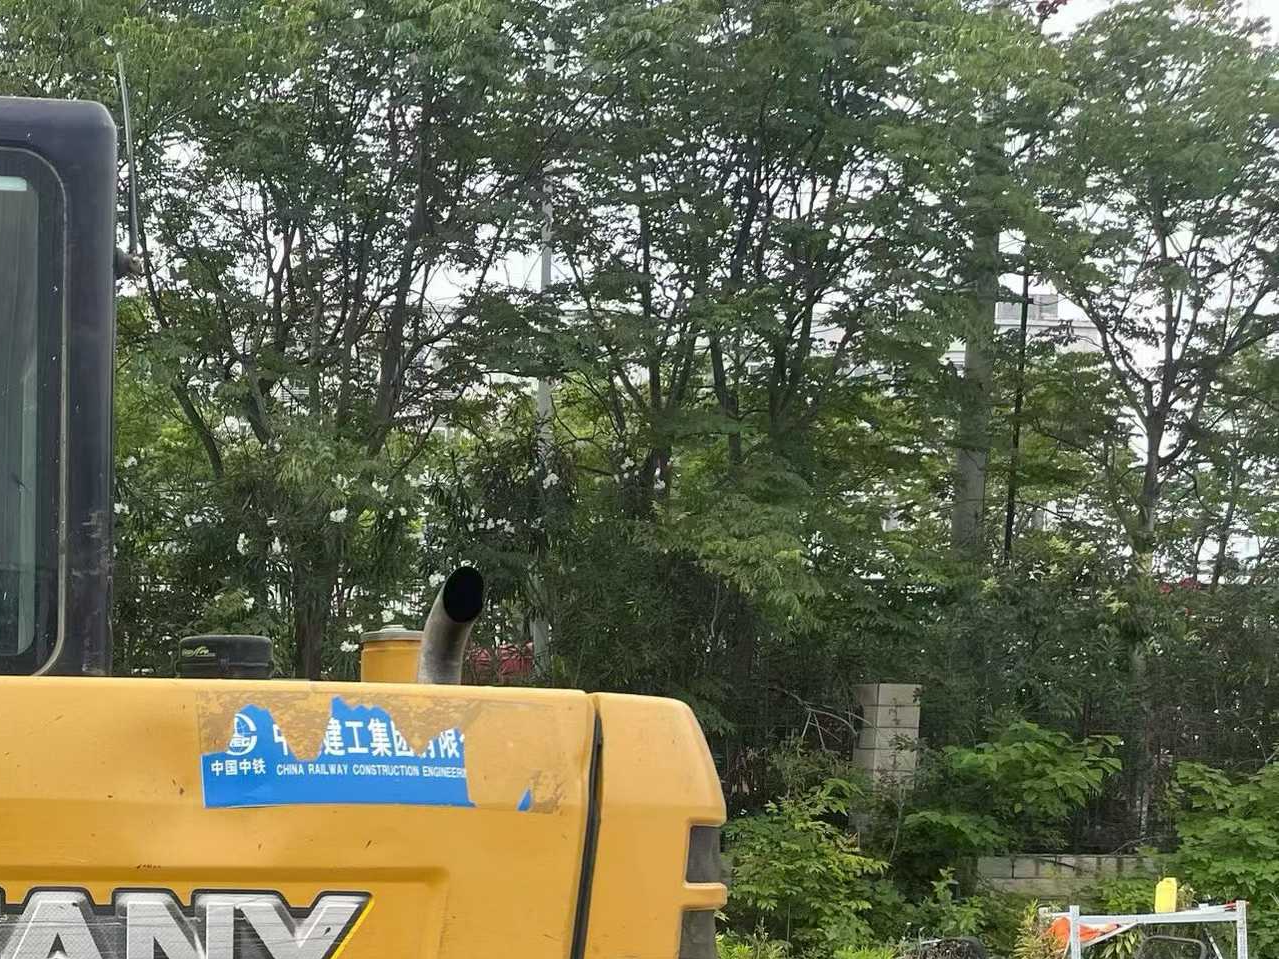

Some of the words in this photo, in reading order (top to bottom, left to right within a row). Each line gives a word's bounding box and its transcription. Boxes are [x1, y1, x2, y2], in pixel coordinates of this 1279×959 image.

[211, 757, 267, 776] 中国中铁
[276, 763, 305, 776] CHINA
[308, 763, 350, 776] RAILWAY
[353, 763, 420, 777] CONSTRUCTION
